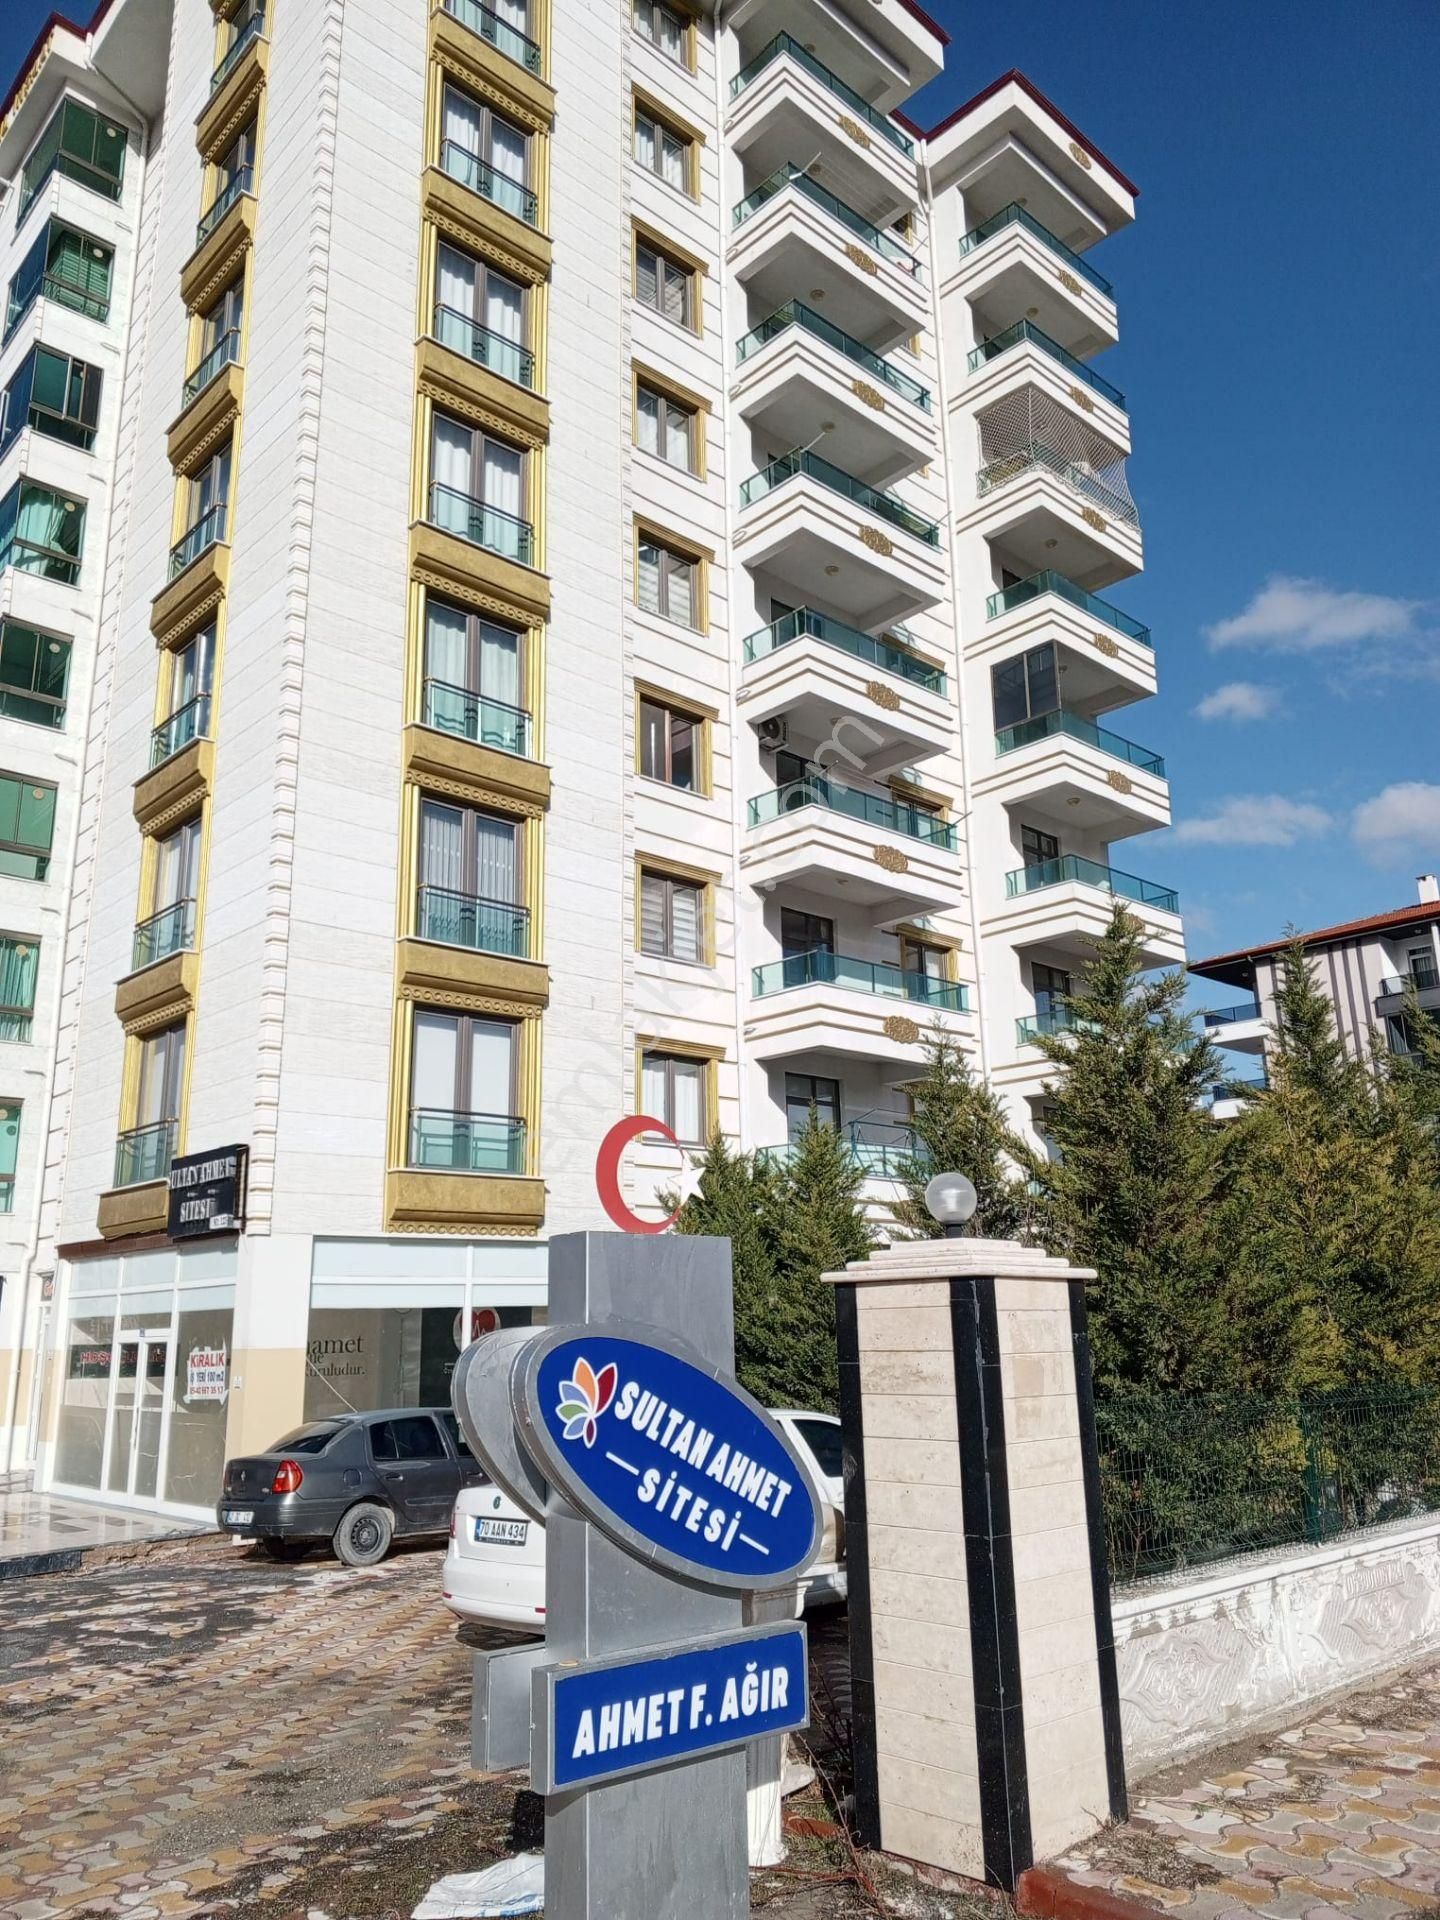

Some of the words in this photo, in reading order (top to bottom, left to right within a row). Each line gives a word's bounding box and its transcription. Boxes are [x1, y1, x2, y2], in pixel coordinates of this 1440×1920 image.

[614, 1381, 715, 1470] SULTAN
[705, 1442, 792, 1518] AHMET
[480, 1521, 490, 1535] 70
[491, 1522, 507, 1537] AAN
[508, 1524, 525, 1538] 434
[637, 1468, 742, 1551] SİTESİ
[572, 1688, 685, 1759] AHMET
[690, 1683, 714, 1730] F.
[719, 1661, 789, 1723] AĞIR
